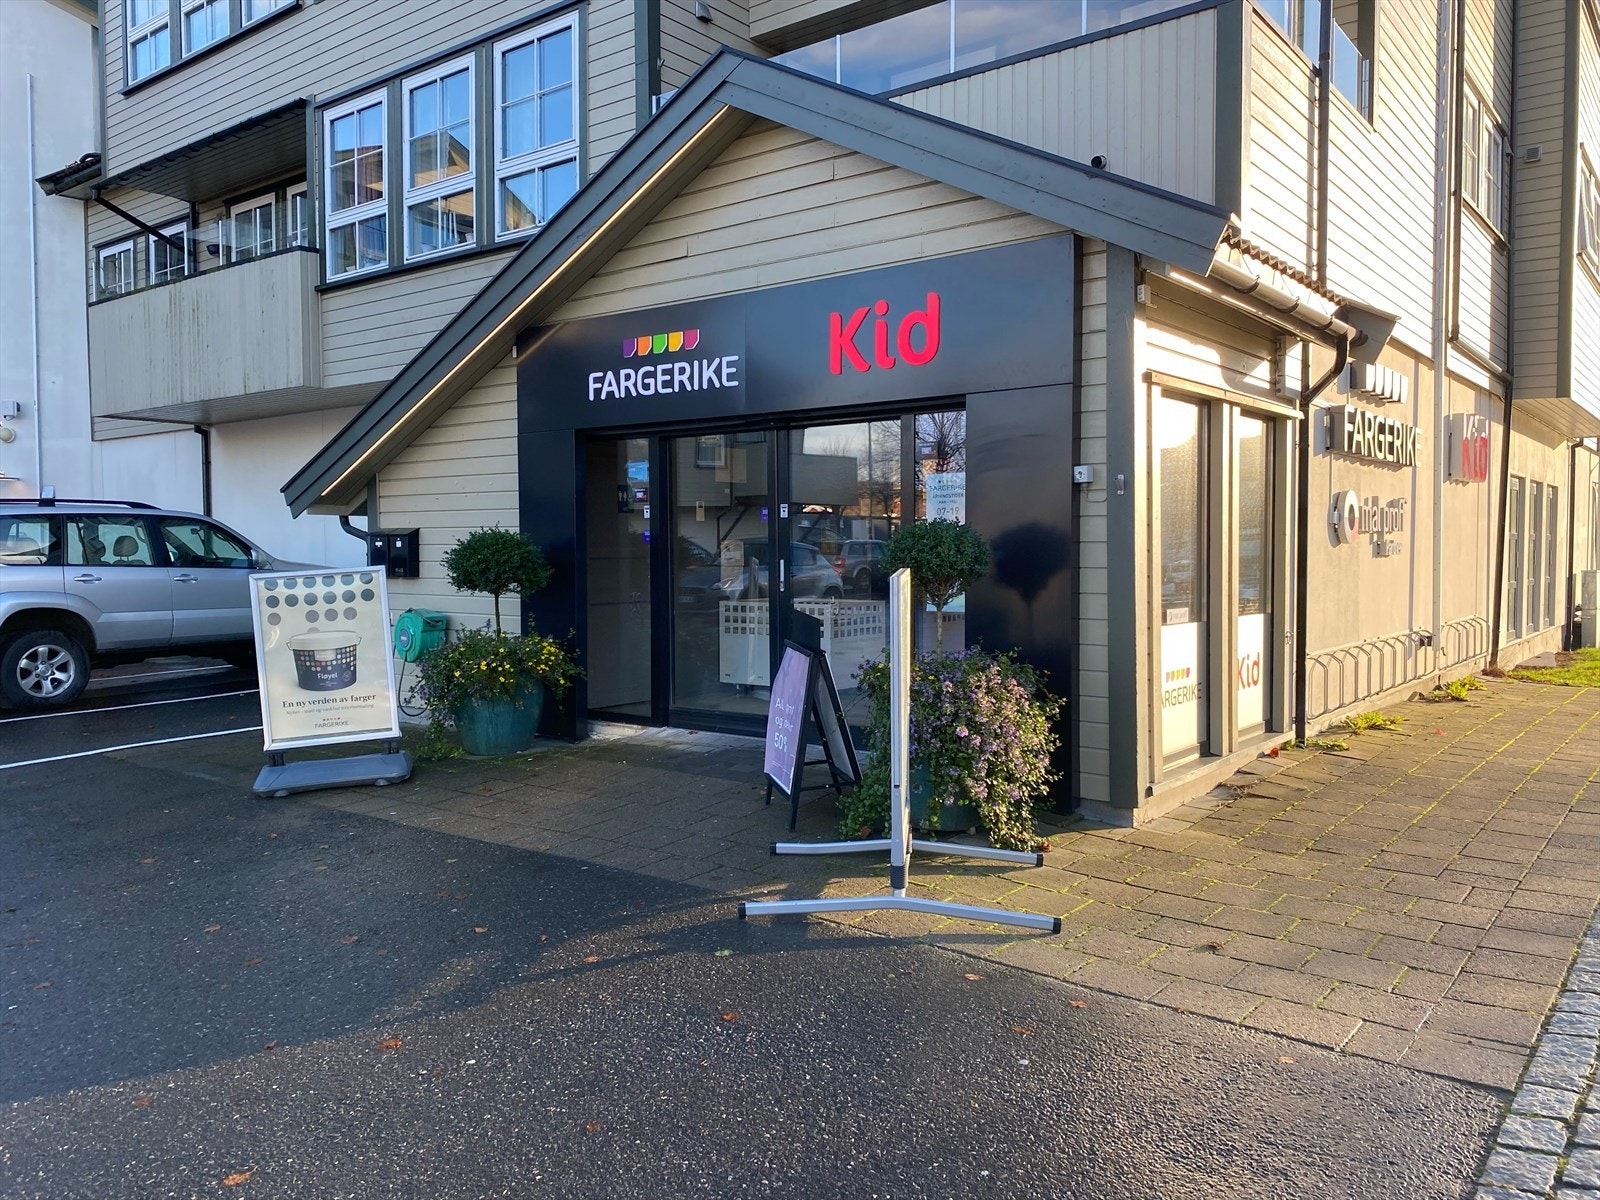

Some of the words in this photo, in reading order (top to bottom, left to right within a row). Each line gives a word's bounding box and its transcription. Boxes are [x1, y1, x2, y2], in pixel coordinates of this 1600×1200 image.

[829, 291, 941, 376] Kid
[588, 355, 739, 402] FARGERIKE
[1343, 404, 1423, 468] FARGERIKE
[1462, 412, 1489, 482] Kid
[937, 507, 960, 516] 07-19
[317, 672, 338, 680] Fløyel
[308, 697, 338, 706] verden
[350, 694, 376, 703] farger
